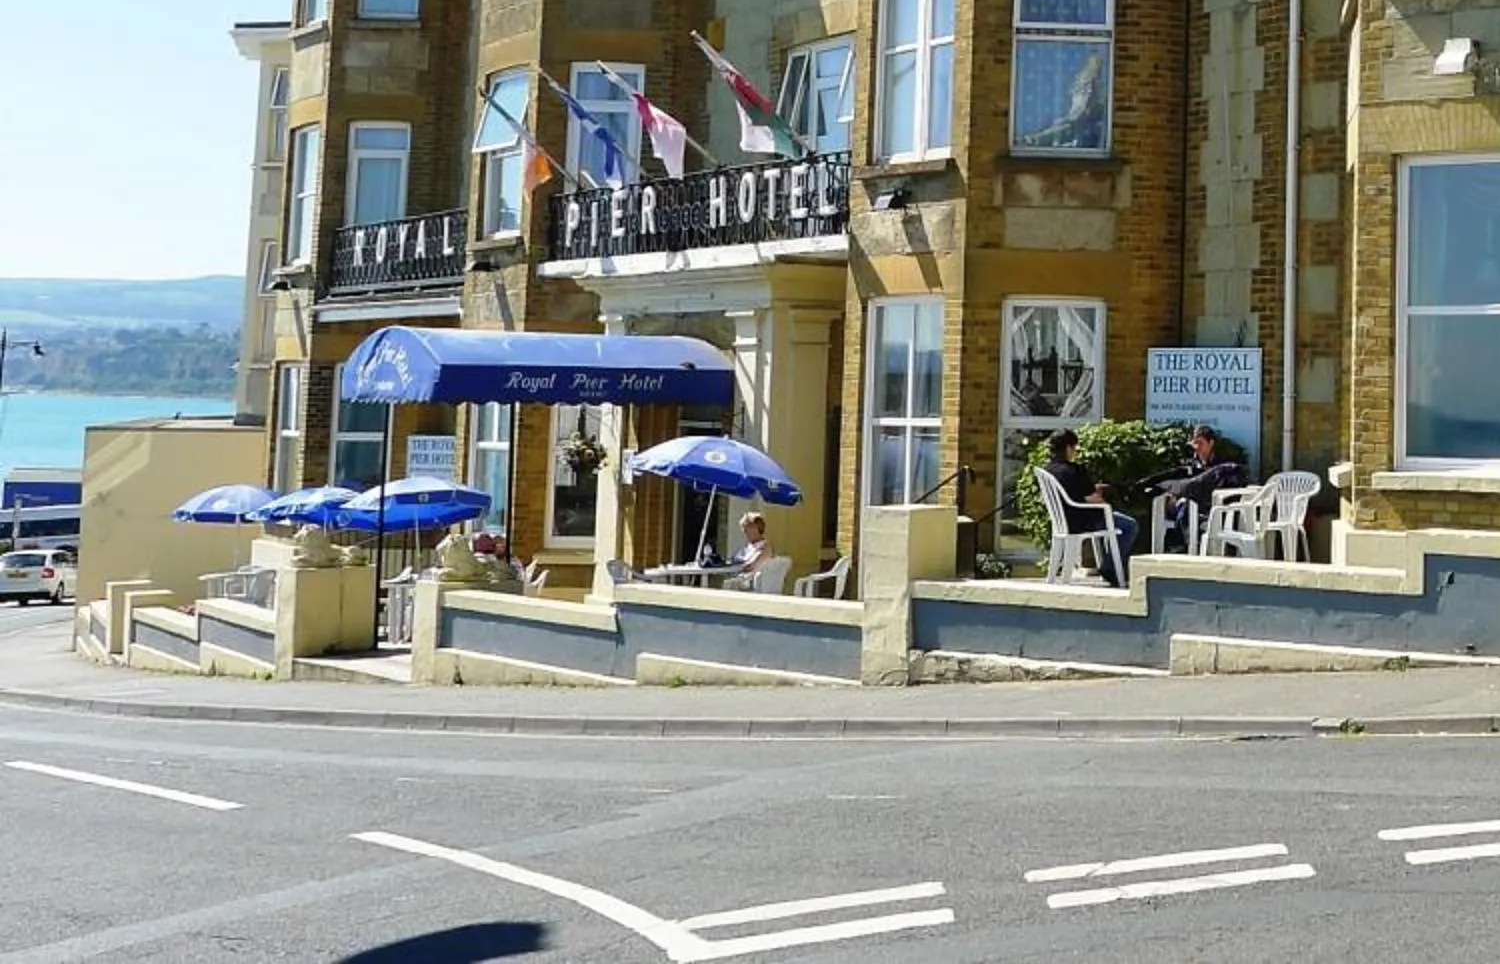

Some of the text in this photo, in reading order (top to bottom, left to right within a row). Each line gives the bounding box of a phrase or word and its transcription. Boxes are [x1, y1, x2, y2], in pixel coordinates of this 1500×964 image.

[354, 162, 839, 266] ROYAL PIER HOTEL
[1154, 353, 1255, 371] THE ROYAL
[505, 371, 664, 393] Royal Pier Hotel
[1153, 375, 1255, 395] PIER HOTEL
